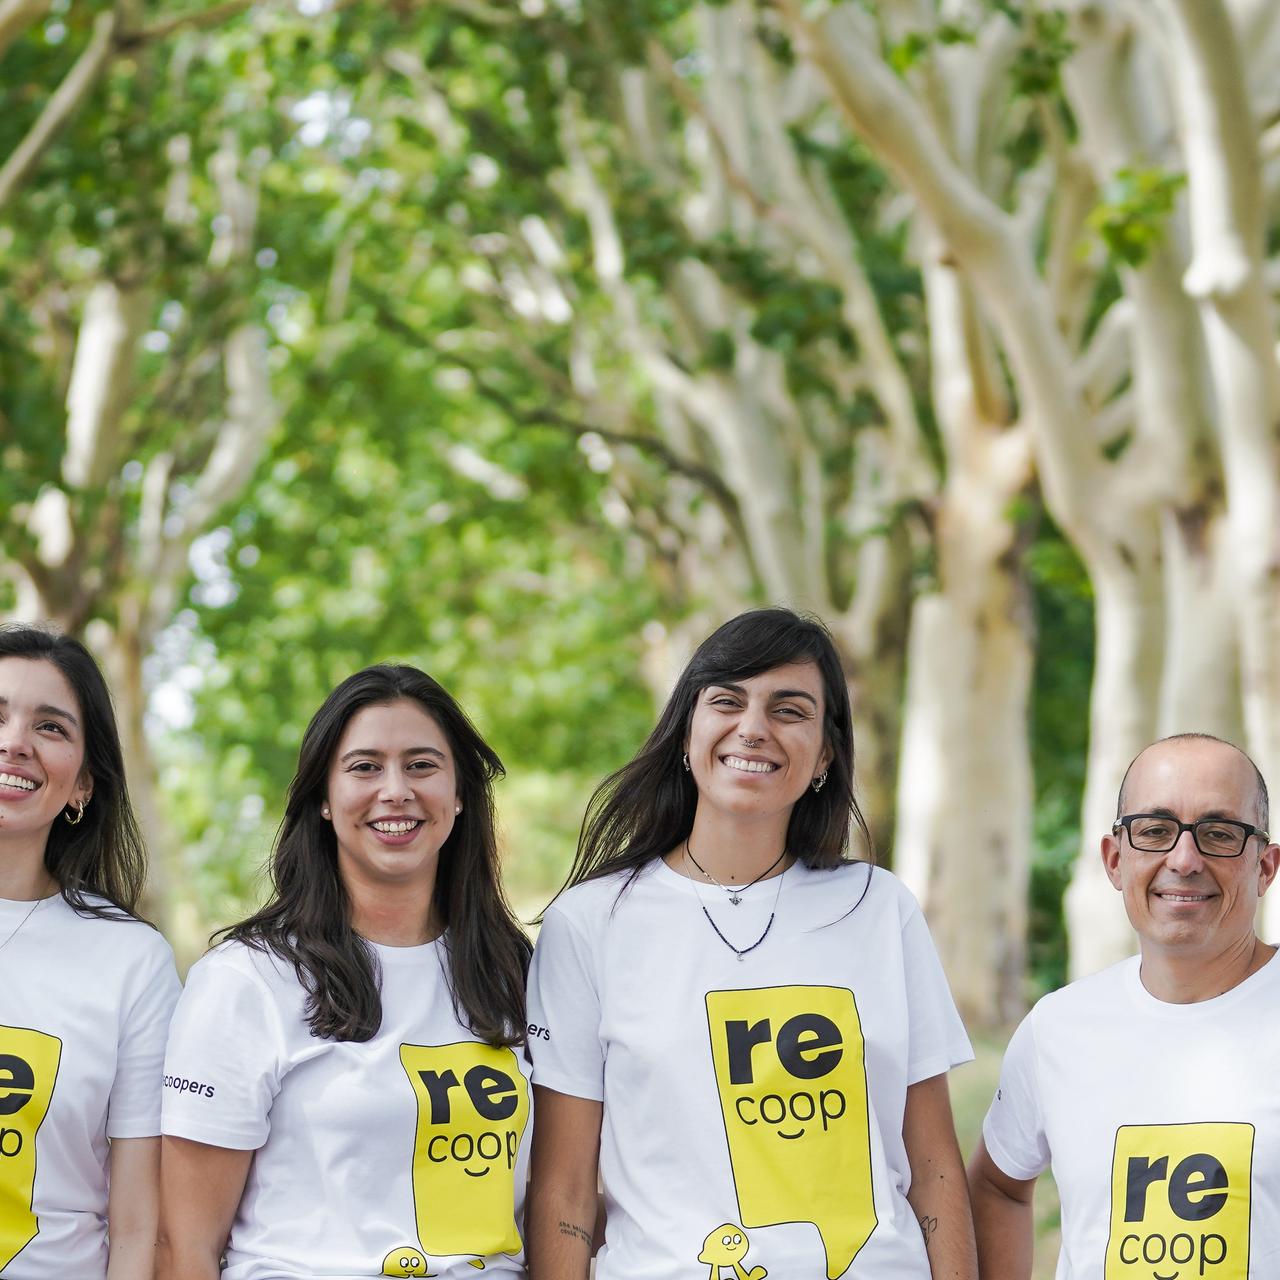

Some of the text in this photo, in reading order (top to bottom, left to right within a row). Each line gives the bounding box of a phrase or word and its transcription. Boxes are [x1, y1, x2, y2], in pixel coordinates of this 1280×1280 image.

[724, 1013, 844, 1085] re
[417, 1064, 519, 1125] re
[735, 1089, 846, 1132] coop
[427, 1130, 517, 1170] coop
[1123, 1153, 1229, 1223] re
[1119, 1233, 1228, 1276] coop
